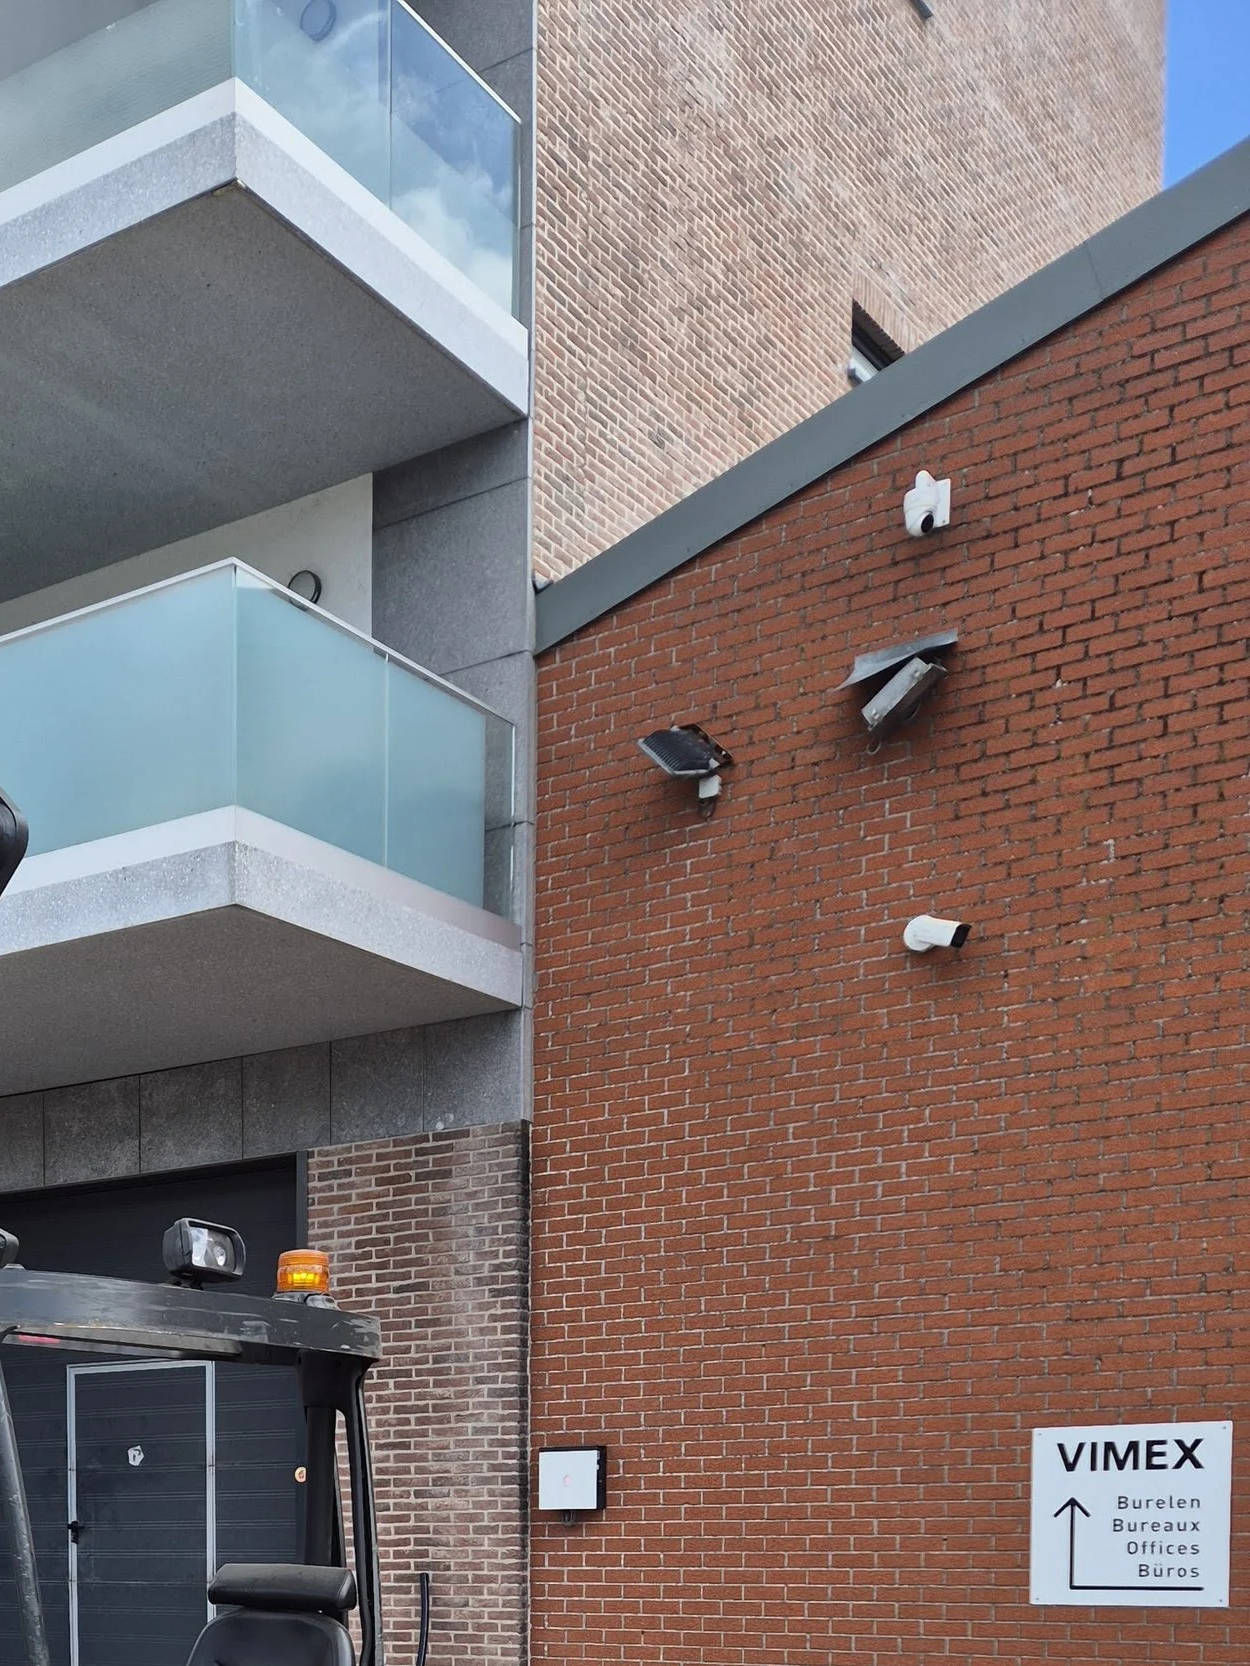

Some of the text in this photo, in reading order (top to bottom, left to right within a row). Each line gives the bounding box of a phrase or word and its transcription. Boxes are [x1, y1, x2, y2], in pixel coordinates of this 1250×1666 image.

[1056, 1438, 1204, 1473] VIMEX
[1117, 1495, 1201, 1510] Burelen
[1112, 1518, 1201, 1533] Bureaux
[1126, 1541, 1200, 1555] Offices
[1138, 1563, 1200, 1578] Büros
